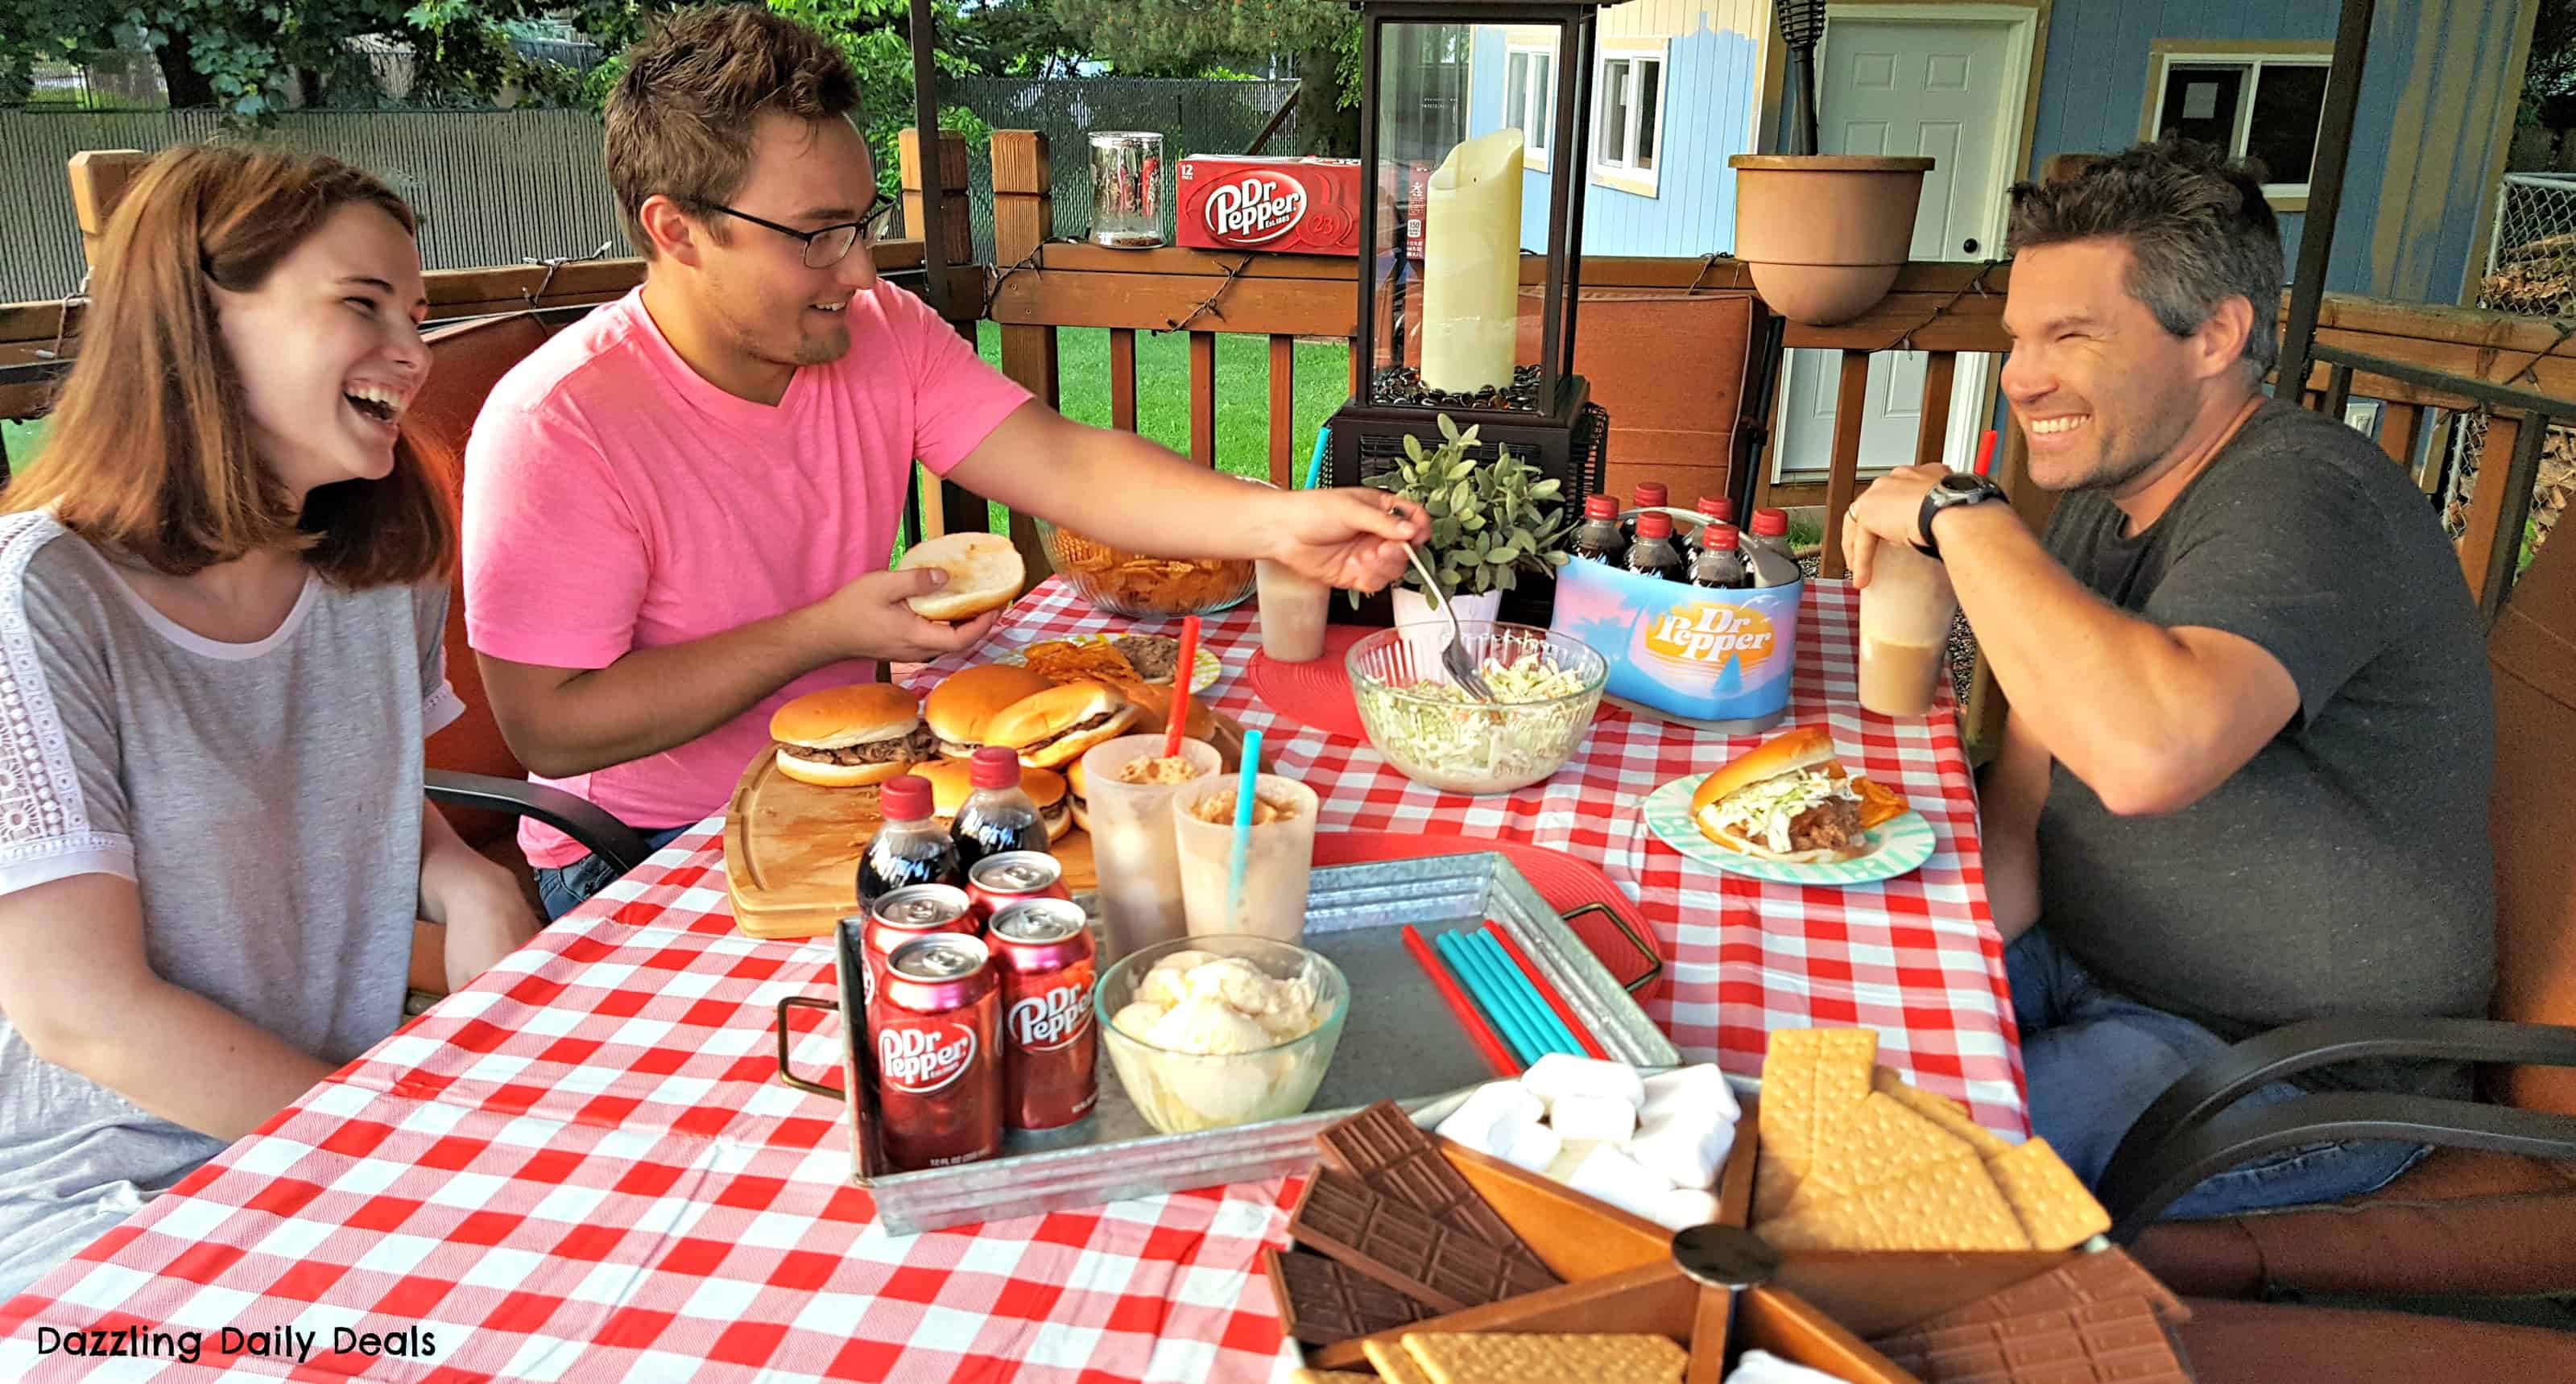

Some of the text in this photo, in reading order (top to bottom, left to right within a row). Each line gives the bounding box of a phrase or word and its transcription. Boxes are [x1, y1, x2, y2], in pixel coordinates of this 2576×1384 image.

[1181, 164, 1193, 175] 12
[1241, 178, 1277, 207] Dr
[1210, 184, 1300, 236] Pepper
[1313, 213, 1333, 234] 23
[1692, 606, 1751, 633] Dr
[1655, 614, 1772, 662] Pepper
[1046, 982, 1082, 1018] Dr
[880, 1029, 969, 1084] Pepper
[901, 1028, 942, 1057] Dr
